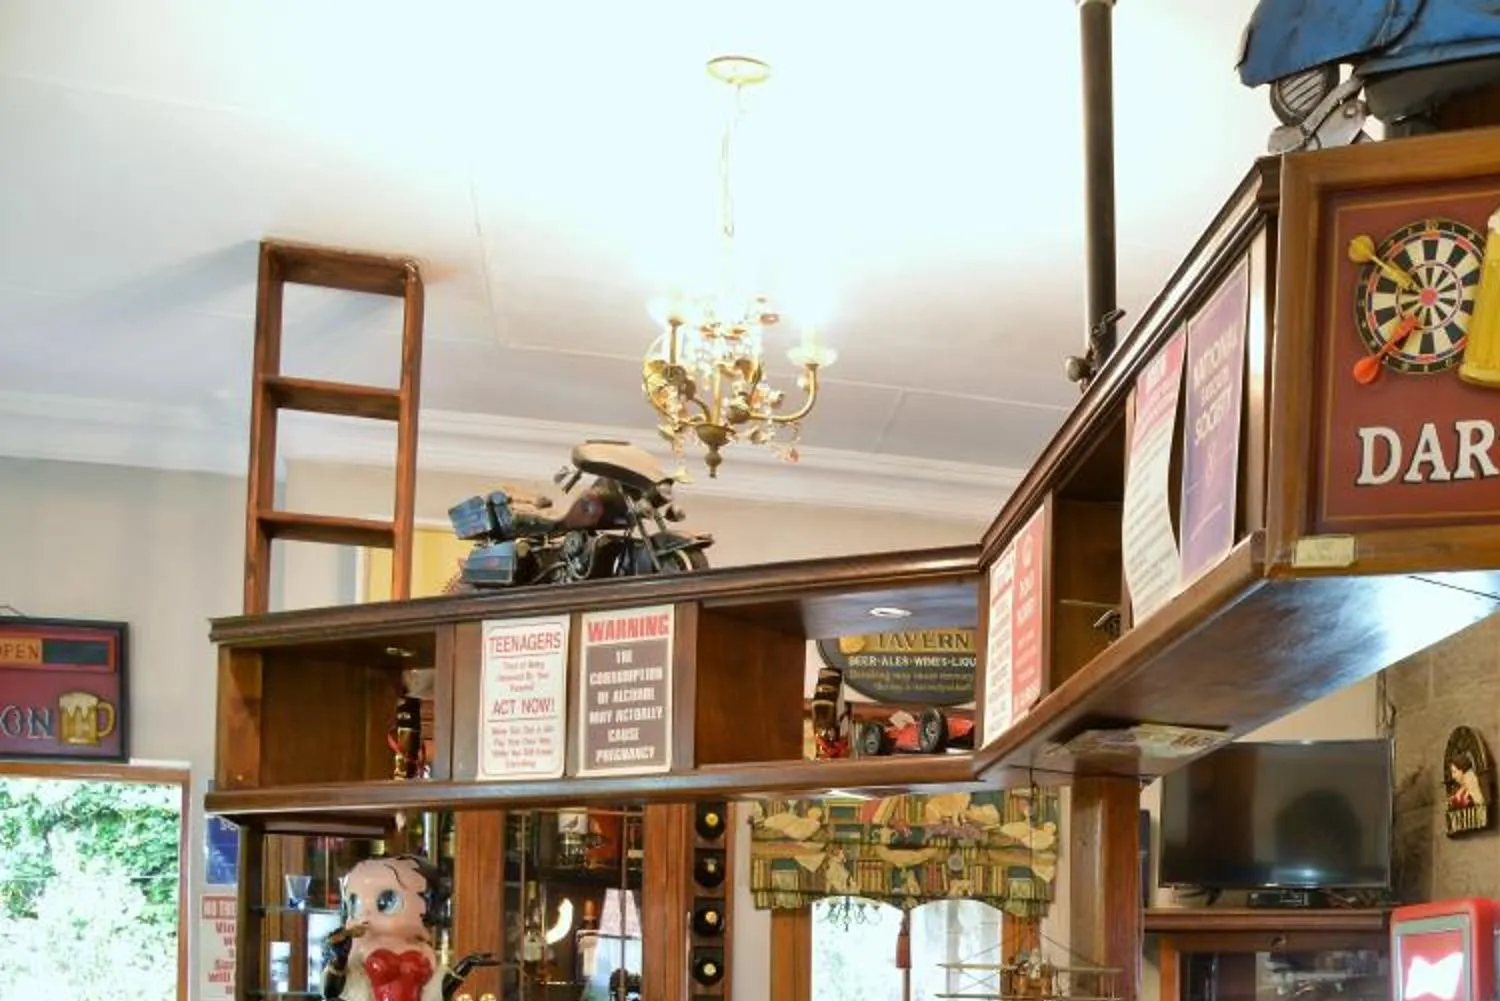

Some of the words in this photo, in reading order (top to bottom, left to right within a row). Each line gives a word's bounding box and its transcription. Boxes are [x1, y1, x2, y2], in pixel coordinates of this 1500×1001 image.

[587, 614, 669, 642] WARNING
[0, 643, 40, 660] PEN
[489, 632, 561, 653] TEENAGERS
[493, 700, 516, 715] ACT
[521, 698, 555, 714] NOW!
